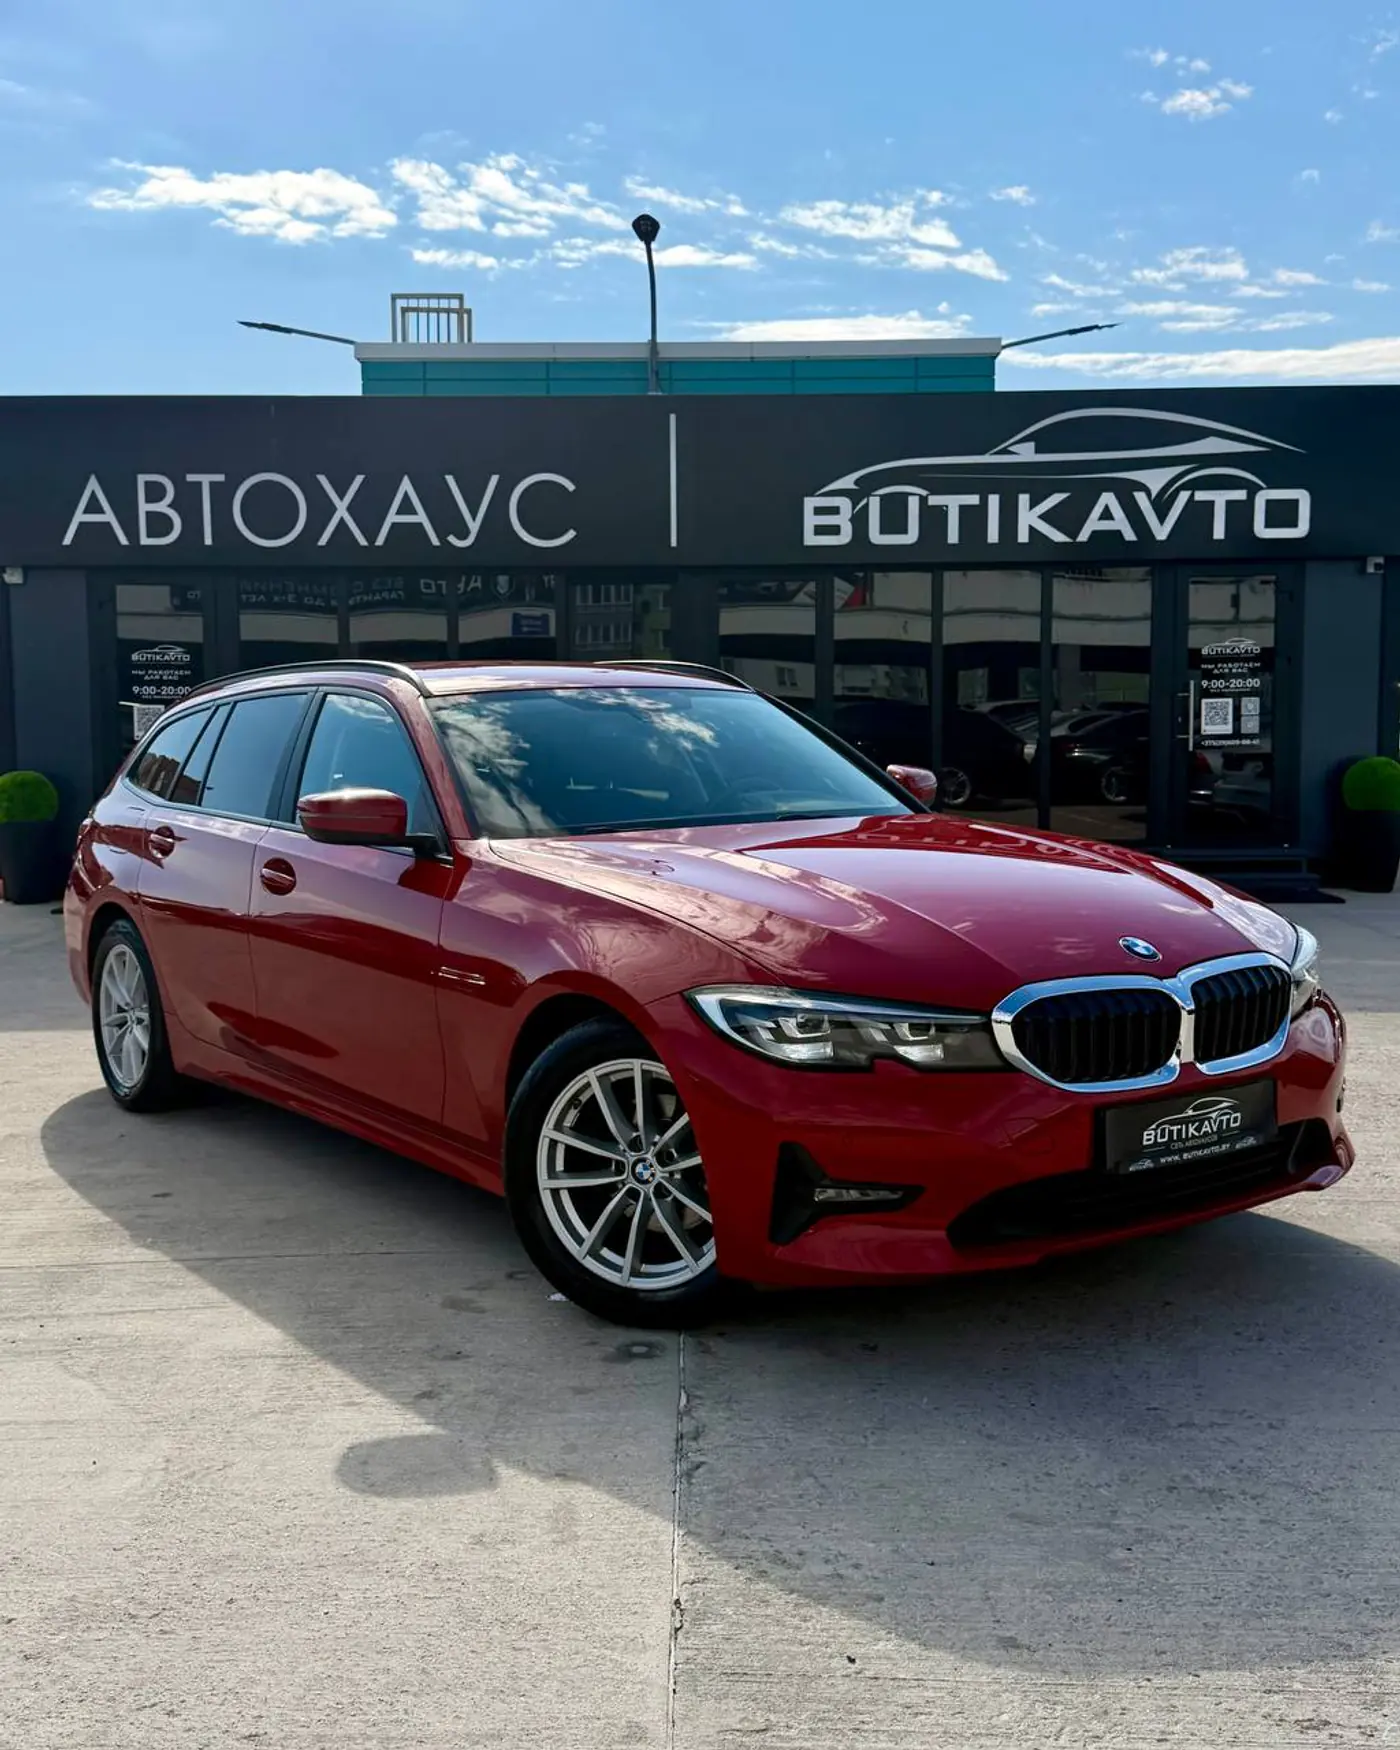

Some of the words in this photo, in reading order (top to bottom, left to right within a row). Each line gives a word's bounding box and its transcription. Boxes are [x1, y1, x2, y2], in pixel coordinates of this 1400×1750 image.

[62, 471, 577, 548] АВТОХАУС
[803, 488, 1311, 546] BUTIKAVTO
[1201, 646, 1261, 655] BUTIKAVTO
[131, 653, 191, 662] BUTIKAVTO
[1201, 678, 1261, 689] 9:00-20:00
[132, 685, 191, 695] 9:00-20:00
[1142, 1111, 1242, 1146] BUTIKAVTO
